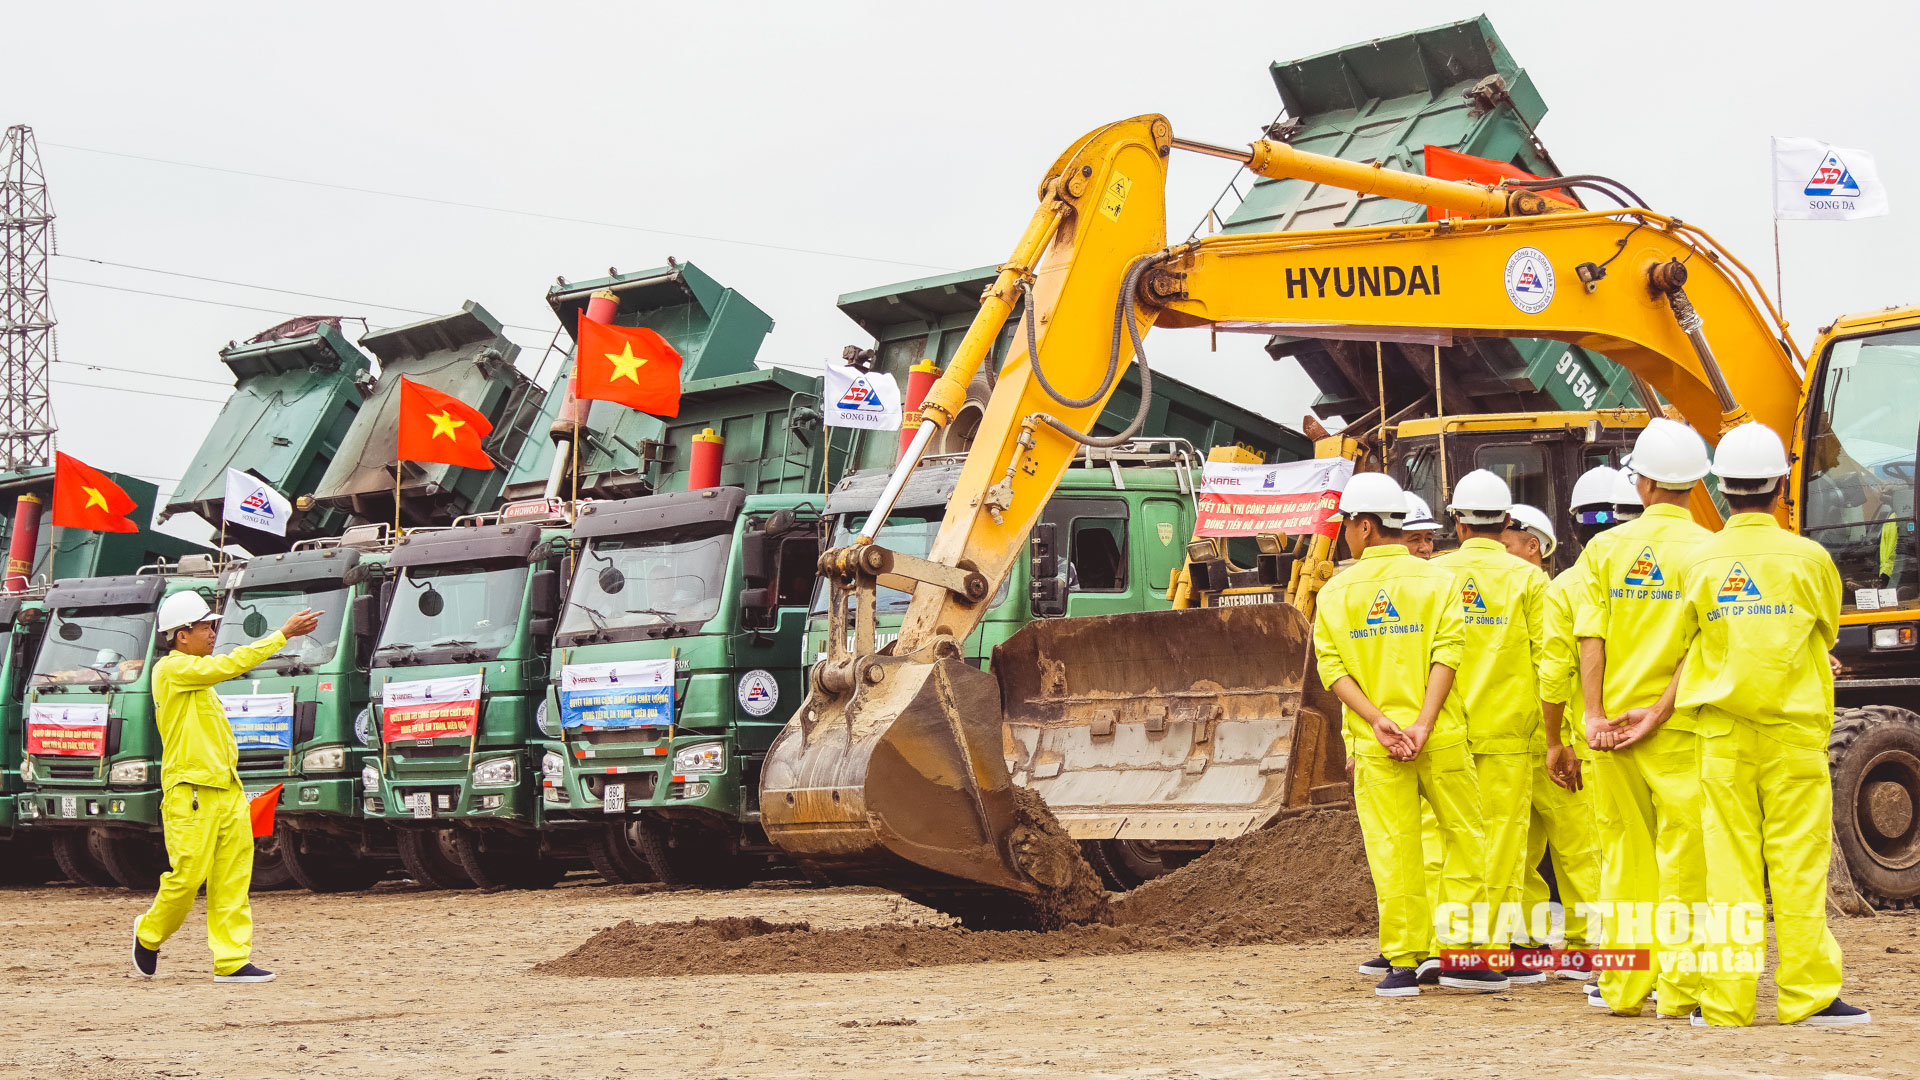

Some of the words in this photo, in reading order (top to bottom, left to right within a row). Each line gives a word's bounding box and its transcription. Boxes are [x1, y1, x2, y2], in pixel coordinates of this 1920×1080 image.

[1809, 201, 1840, 210] SONG
[1842, 201, 1855, 210] DA
[1285, 265, 1440, 299] HYUNDAI
[1556, 351, 1597, 410] 9154
[840, 412, 864, 421] SONG
[866, 414, 878, 422] DA
[1209, 477, 1241, 486] HANEL
[1610, 587, 1623, 598] ÔNG
[1626, 589, 1635, 598] TY
[1637, 590, 1649, 599] CP
[1651, 588, 1673, 600] SÔNG
[1675, 590, 1682, 599] Đ
[1218, 594, 1274, 607] CATERPILLAR
[1720, 606, 1730, 617] TY
[1732, 606, 1745, 616] CP
[1747, 603, 1772, 615] SÔNG
[1774, 602, 1787, 614] ĐÀ
[1789, 604, 1794, 614] 2
[1464, 616, 1474, 624] CP
[1476, 615, 1495, 625] SÔNG
[1504, 617, 1508, 625] 2
[1350, 627, 1368, 639] CÔNG
[1369, 627, 1378, 637] TY
[1379, 625, 1388, 636] CP
[1390, 624, 1408, 634] SÔNG
[1410, 622, 1419, 633] ĐÀ
[1420, 624, 1424, 633] 2
[609, 787, 619, 797] 89C
